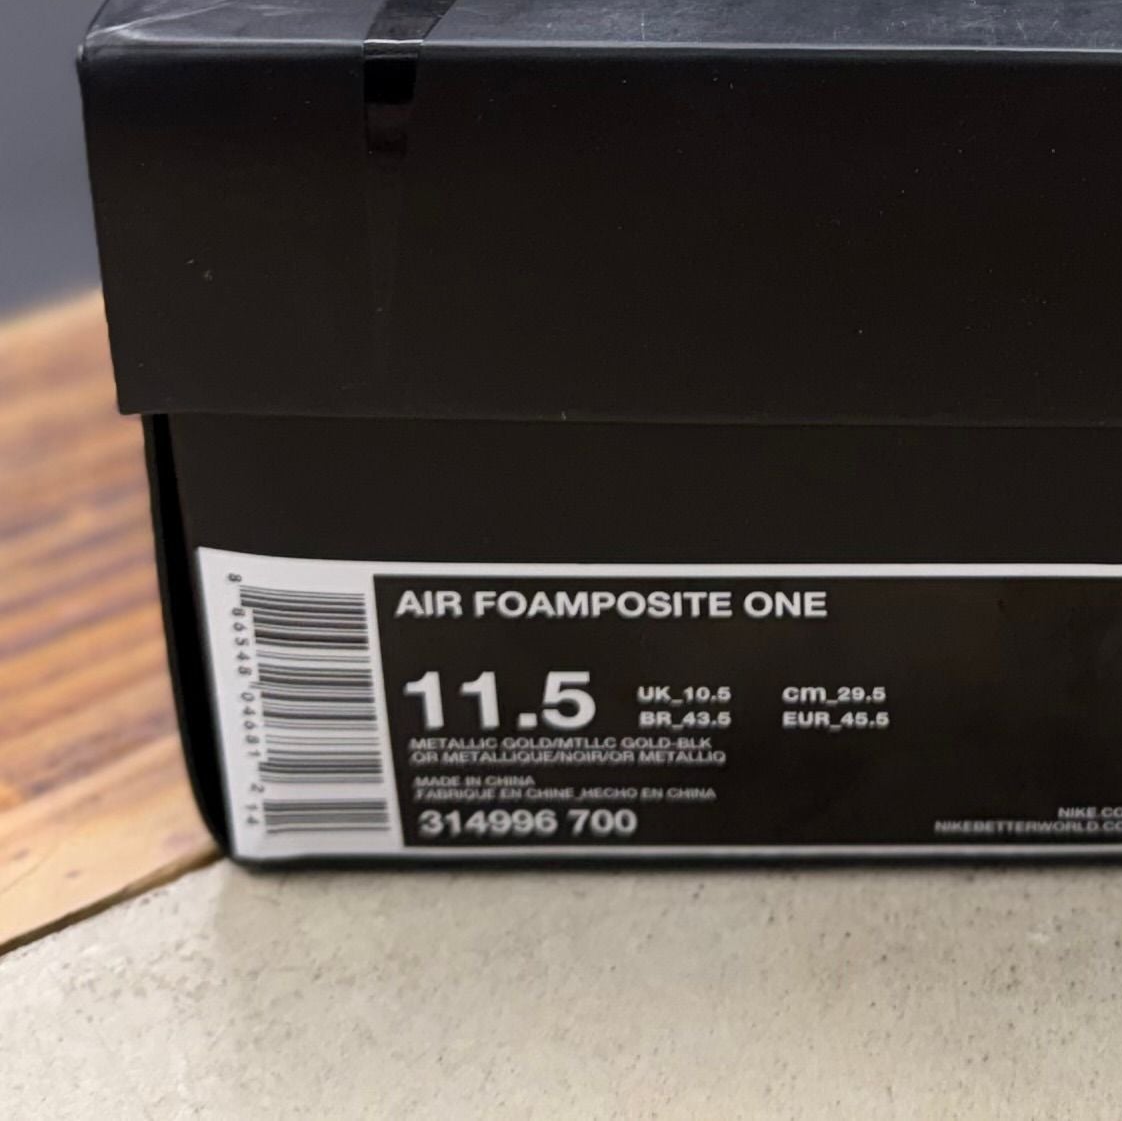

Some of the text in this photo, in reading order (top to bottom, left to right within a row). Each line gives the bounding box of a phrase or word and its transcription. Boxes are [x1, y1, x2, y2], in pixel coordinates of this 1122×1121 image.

[396, 589, 829, 618] AIR FOAMPOSITE ONE
[231, 607, 252, 676] 86548
[404, 671, 597, 730] 11.5
[637, 686, 732, 706] UK_10.5
[638, 711, 732, 731] BR_43.5
[782, 711, 890, 732] EUR_45.5
[409, 736, 713, 750] METALLIC GOLD/MTLLC GOLD-BLK
[411, 750, 439, 764] OR
[441, 750, 635, 764] METALLIQUE/NOIR/OR
[414, 775, 536, 787] MADE IN CHINA
[414, 788, 496, 800] FABRIQUE
[500, 788, 522, 800] EN
[640, 787, 664, 800] EN
[666, 787, 717, 800] CHINA
[418, 809, 638, 836] 314996 700
